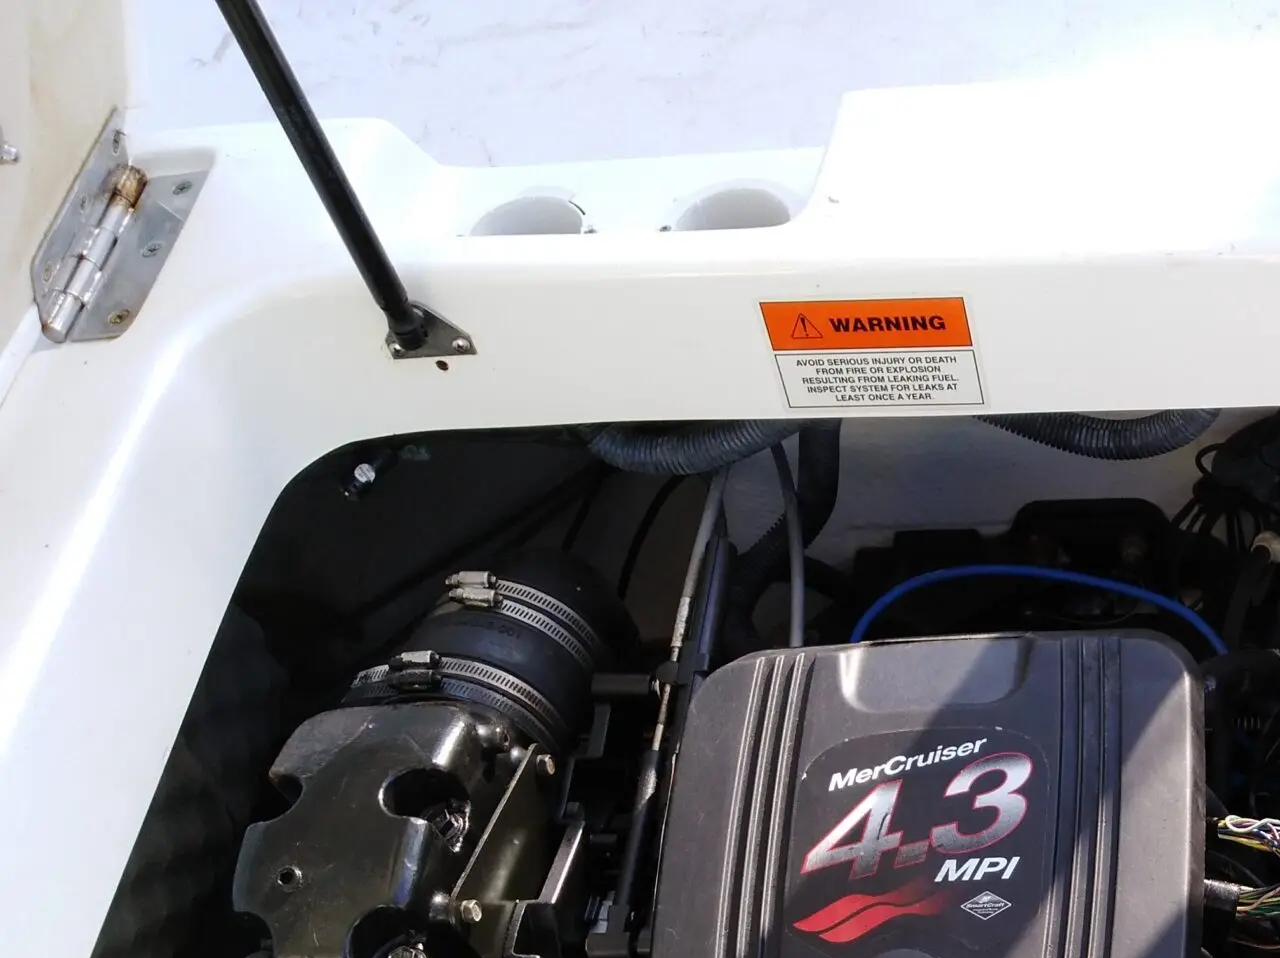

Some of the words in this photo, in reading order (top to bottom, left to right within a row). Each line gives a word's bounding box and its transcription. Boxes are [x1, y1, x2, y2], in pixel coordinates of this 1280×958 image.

[828, 315, 946, 333] WARNING
[796, 359, 825, 367] AVOID
[827, 358, 869, 366] SERIOUS
[871, 356, 905, 365] INJURY
[908, 356, 923, 364] OR
[925, 355, 957, 363] DEATH
[816, 367, 844, 375] FROM
[869, 366, 884, 374] OR
[886, 365, 941, 374] EXPLOSION
[802, 376, 855, 385] RESULTING
[857, 375, 886, 383] FROM
[888, 374, 929, 383] LEAKING
[932, 374, 960, 382] FUEL.
[807, 385, 847, 393] INSPECT
[850, 385, 888, 393] SYSTEM
[913, 383, 944, 391] LEAKS
[835, 394, 866, 402] LEAST
[868, 393, 894, 401] ONCE
[828, 738, 987, 792] MerCruiser
[800, 752, 1033, 880] 4.3
[934, 856, 1021, 883] MPI
